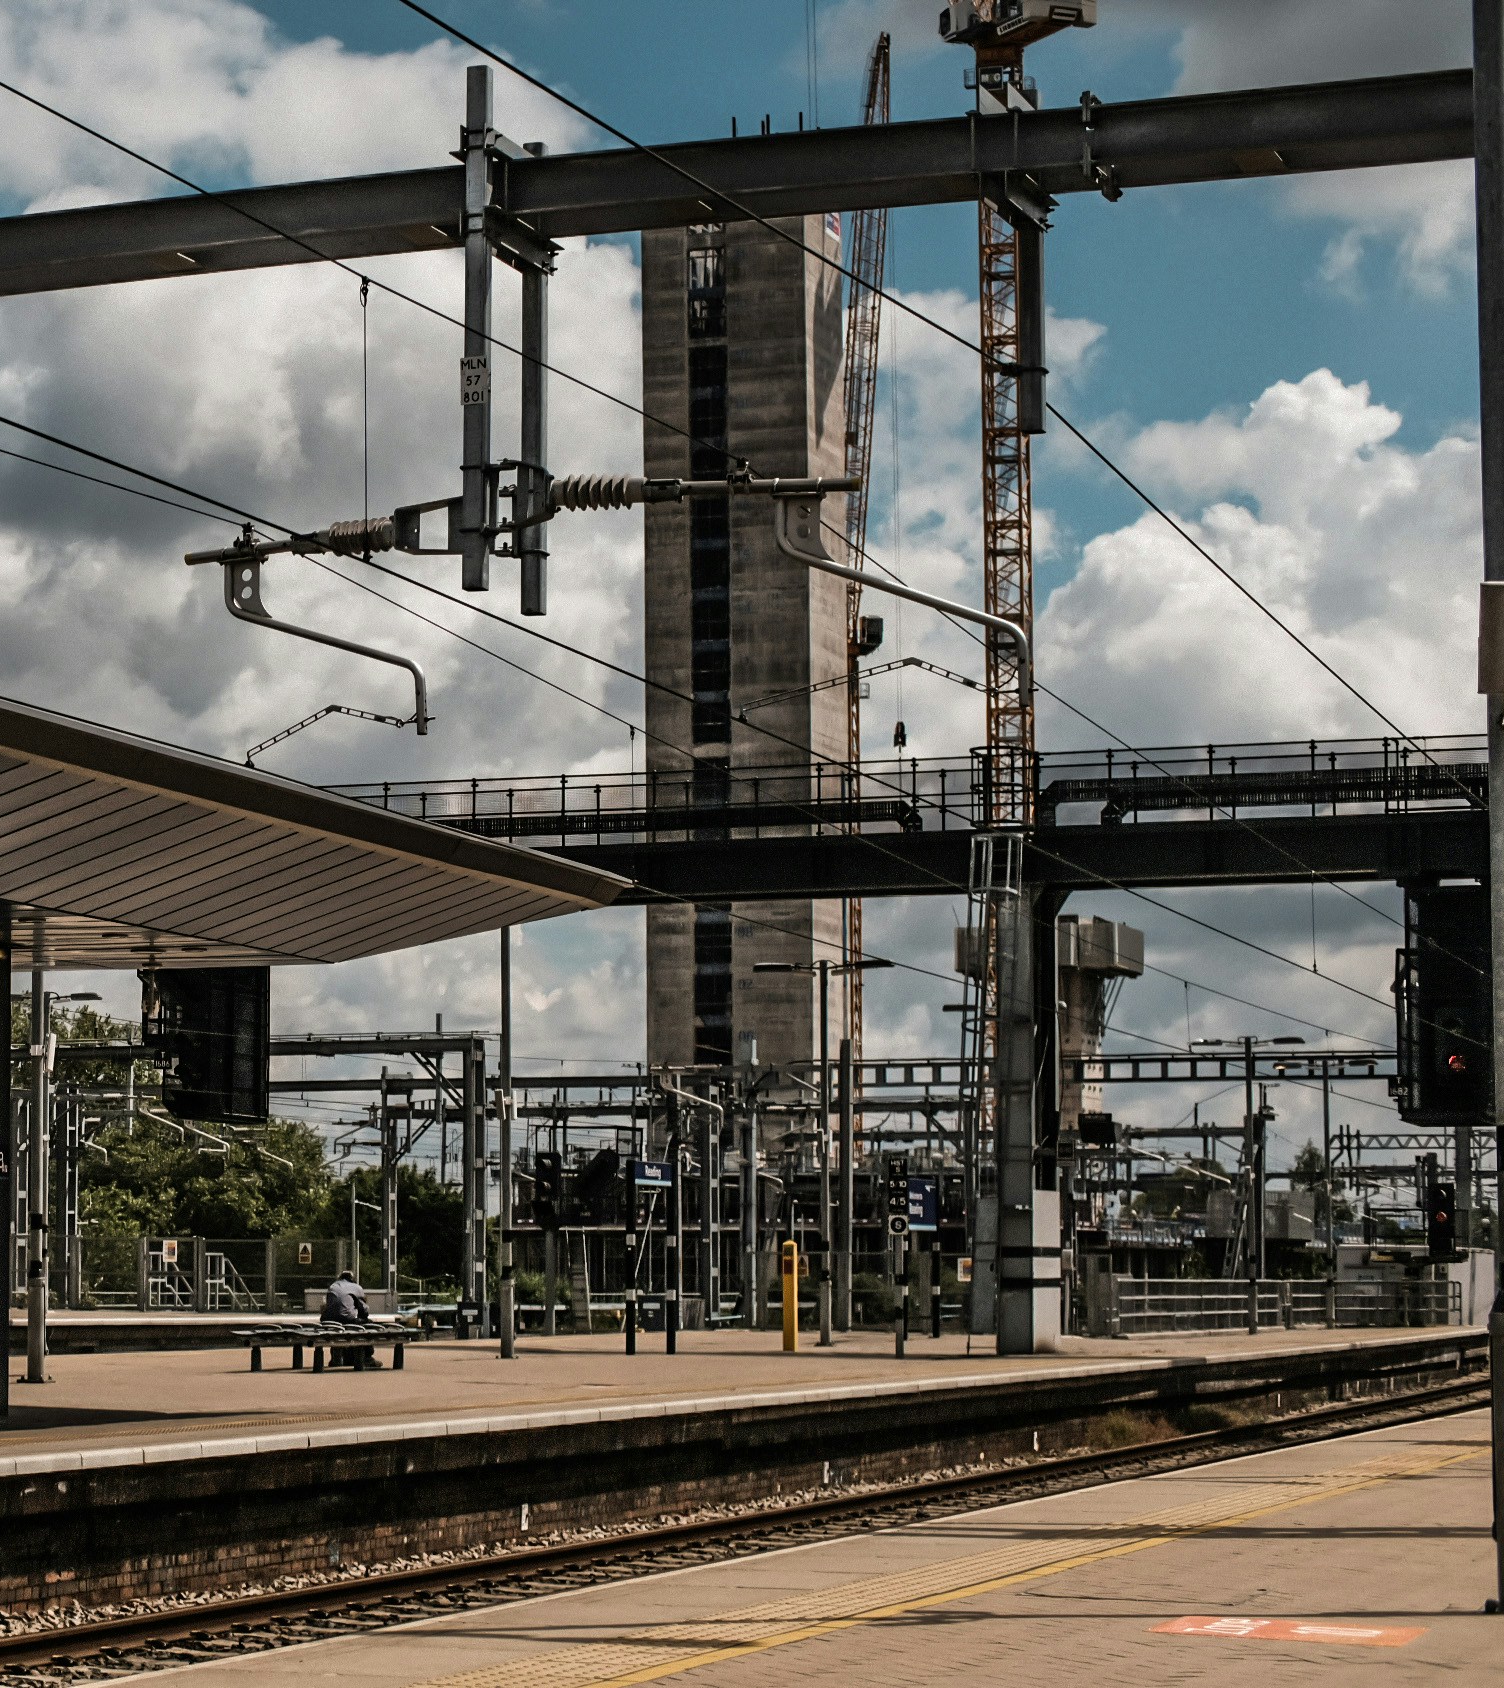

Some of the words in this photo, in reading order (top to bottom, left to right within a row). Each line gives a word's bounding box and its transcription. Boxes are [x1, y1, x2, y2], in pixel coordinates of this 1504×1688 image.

[461, 358, 486, 370] MLN
[466, 374, 480, 386] 57
[464, 391, 484, 403] 801
